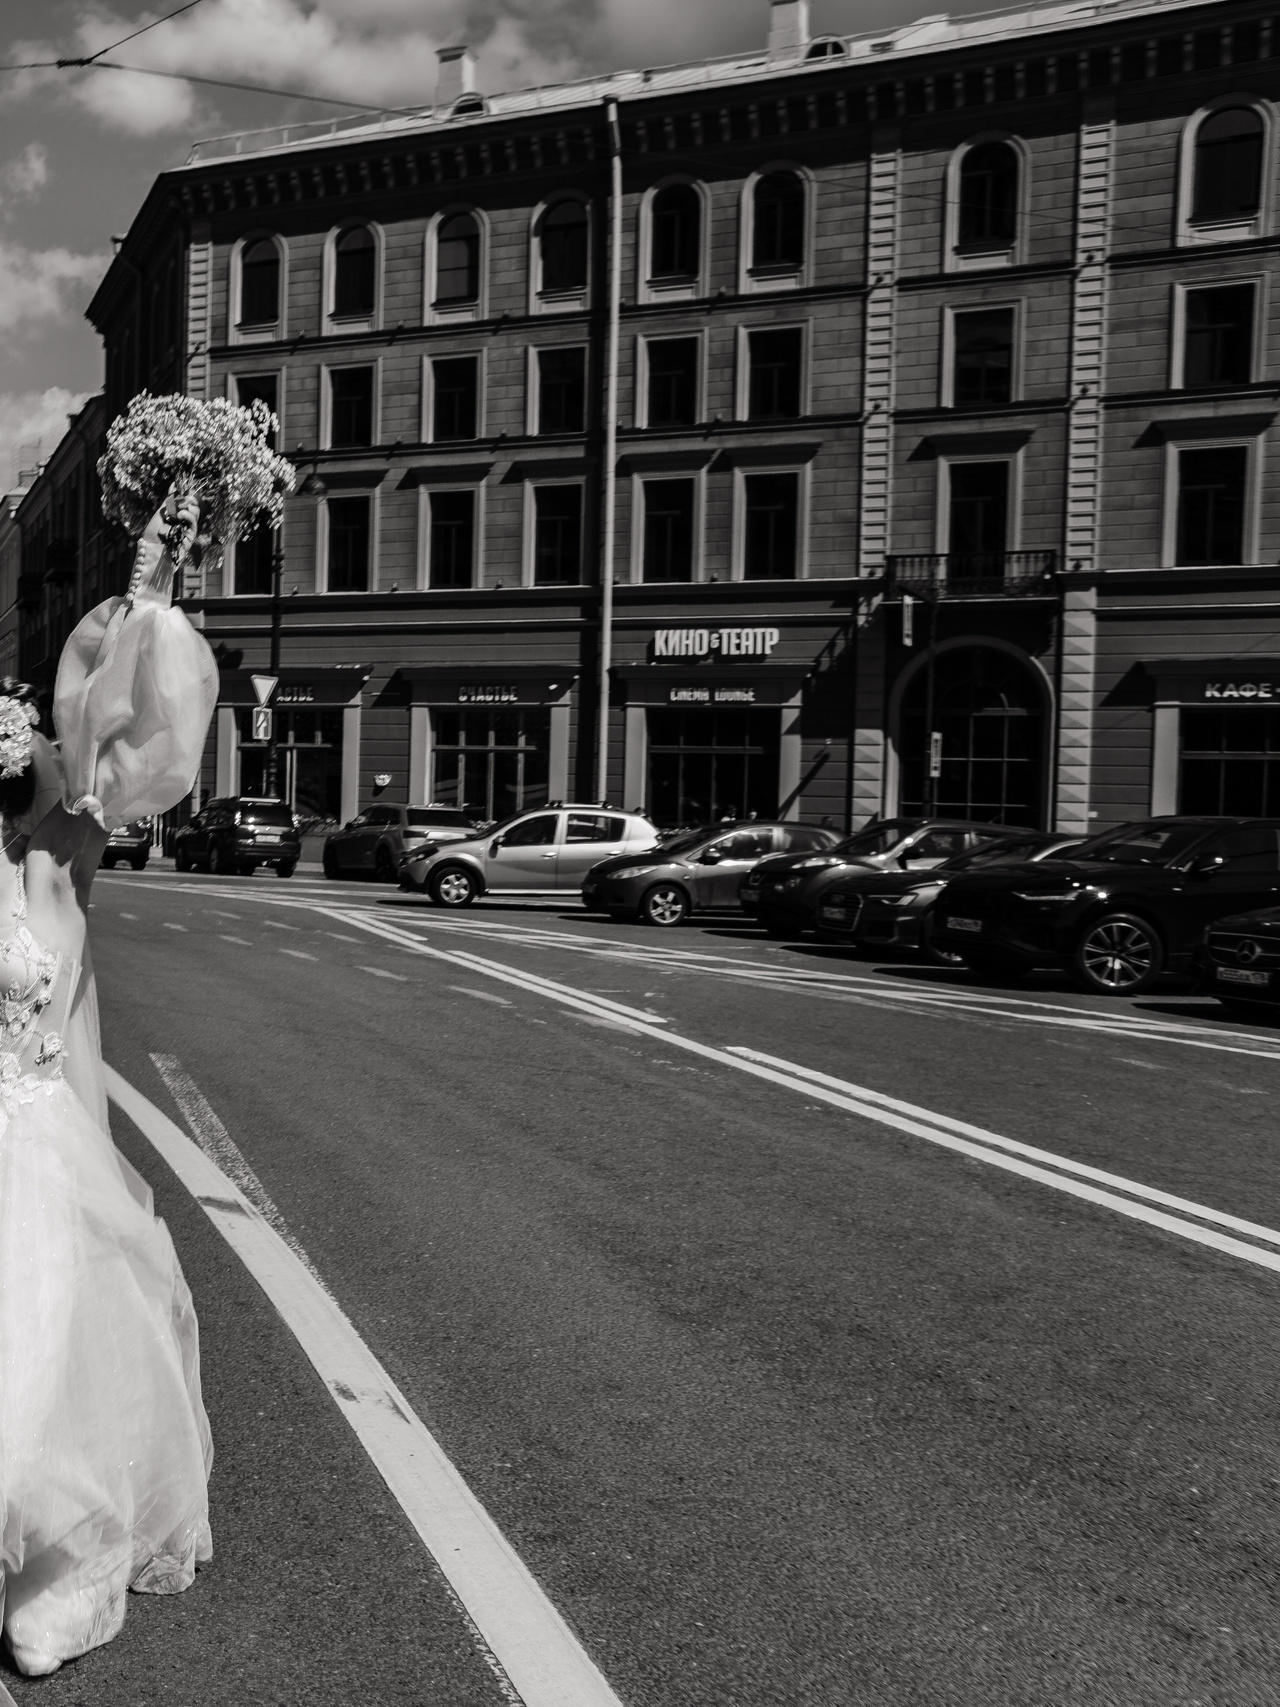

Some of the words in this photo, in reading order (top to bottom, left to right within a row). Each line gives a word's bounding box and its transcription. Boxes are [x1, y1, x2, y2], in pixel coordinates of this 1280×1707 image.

[276, 686, 315, 702] АСТЬЕ
[458, 686, 518, 702] СЧАСТЬЕ
[1204, 683, 1273, 698] КАФЕ
